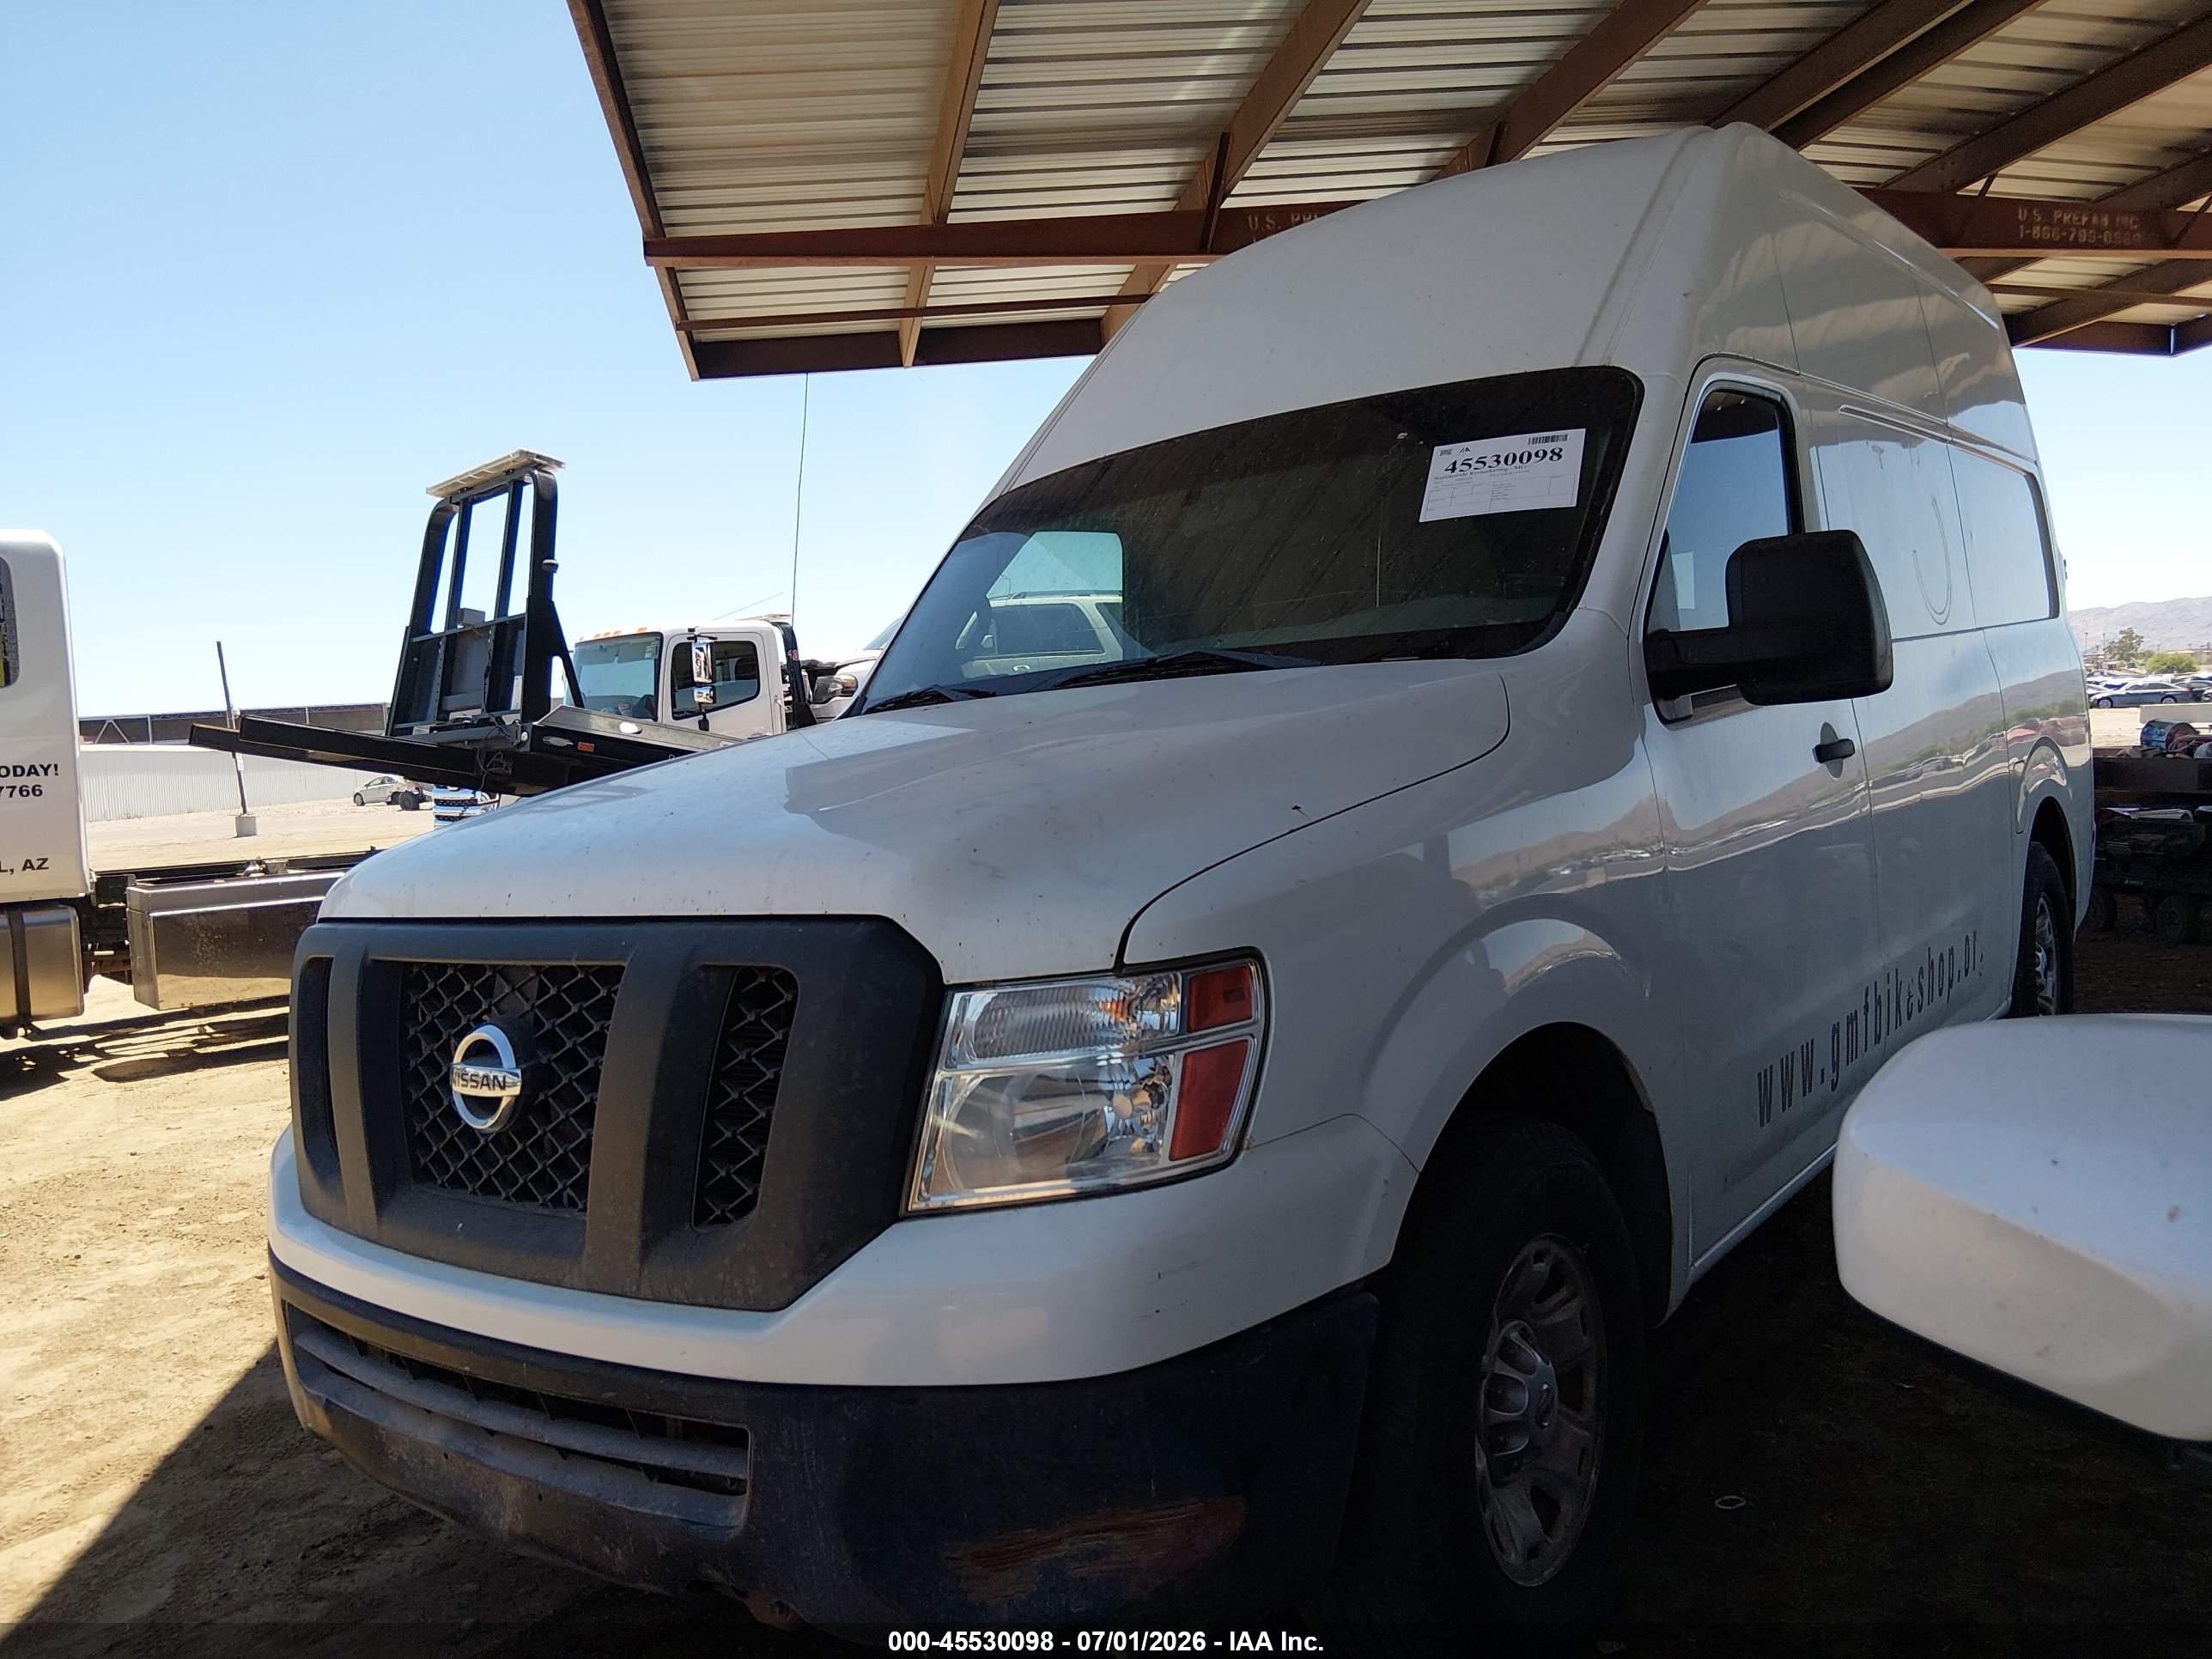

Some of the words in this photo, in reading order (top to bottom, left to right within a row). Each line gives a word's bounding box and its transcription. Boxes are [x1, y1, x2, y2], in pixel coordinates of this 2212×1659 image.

[1444, 447, 1563, 473] 45530098
[21, 858, 50, 872] AZ
[453, 1071, 507, 1091] NISSAN
